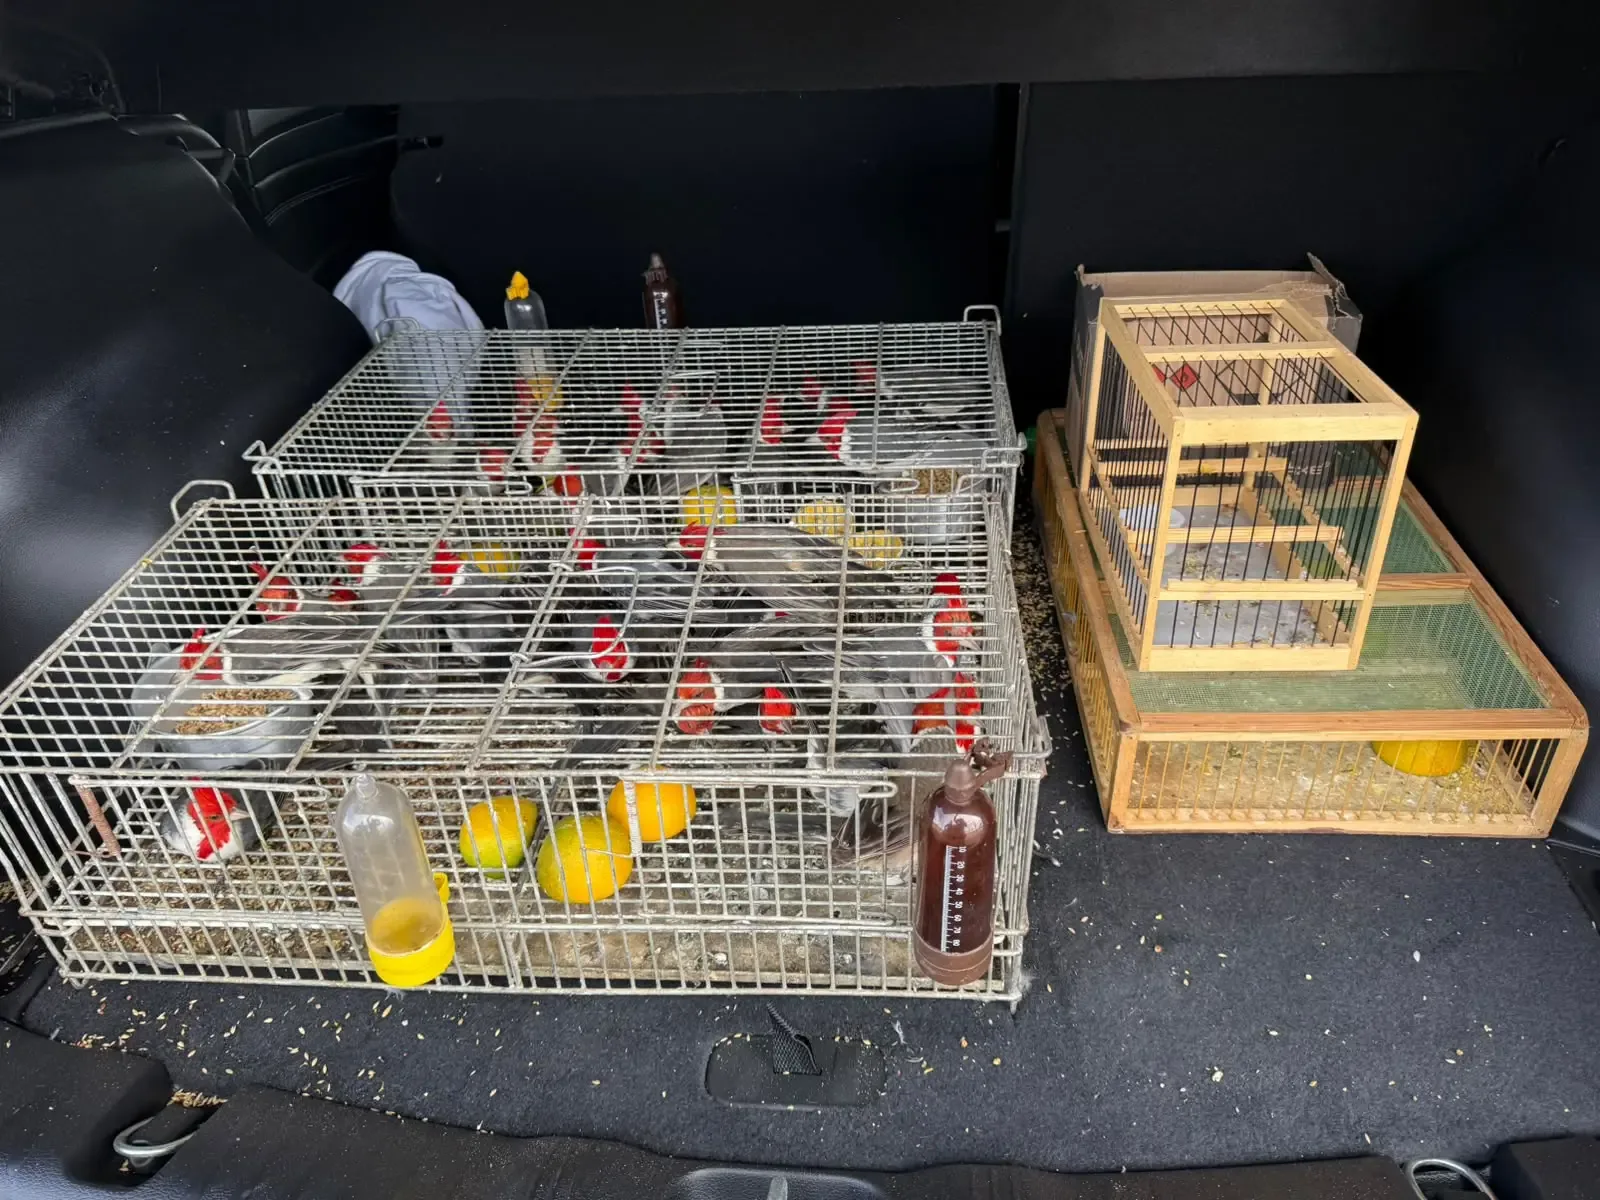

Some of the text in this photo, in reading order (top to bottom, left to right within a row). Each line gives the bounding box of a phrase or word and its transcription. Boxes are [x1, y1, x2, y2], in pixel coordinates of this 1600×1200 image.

[957, 861, 965, 869] 20
[956, 875, 965, 883] 30
[955, 888, 964, 896] 40
[955, 901, 963, 909] 50
[953, 914, 962, 922] 60
[953, 926, 962, 934] 70
[952, 939, 961, 947] 80
